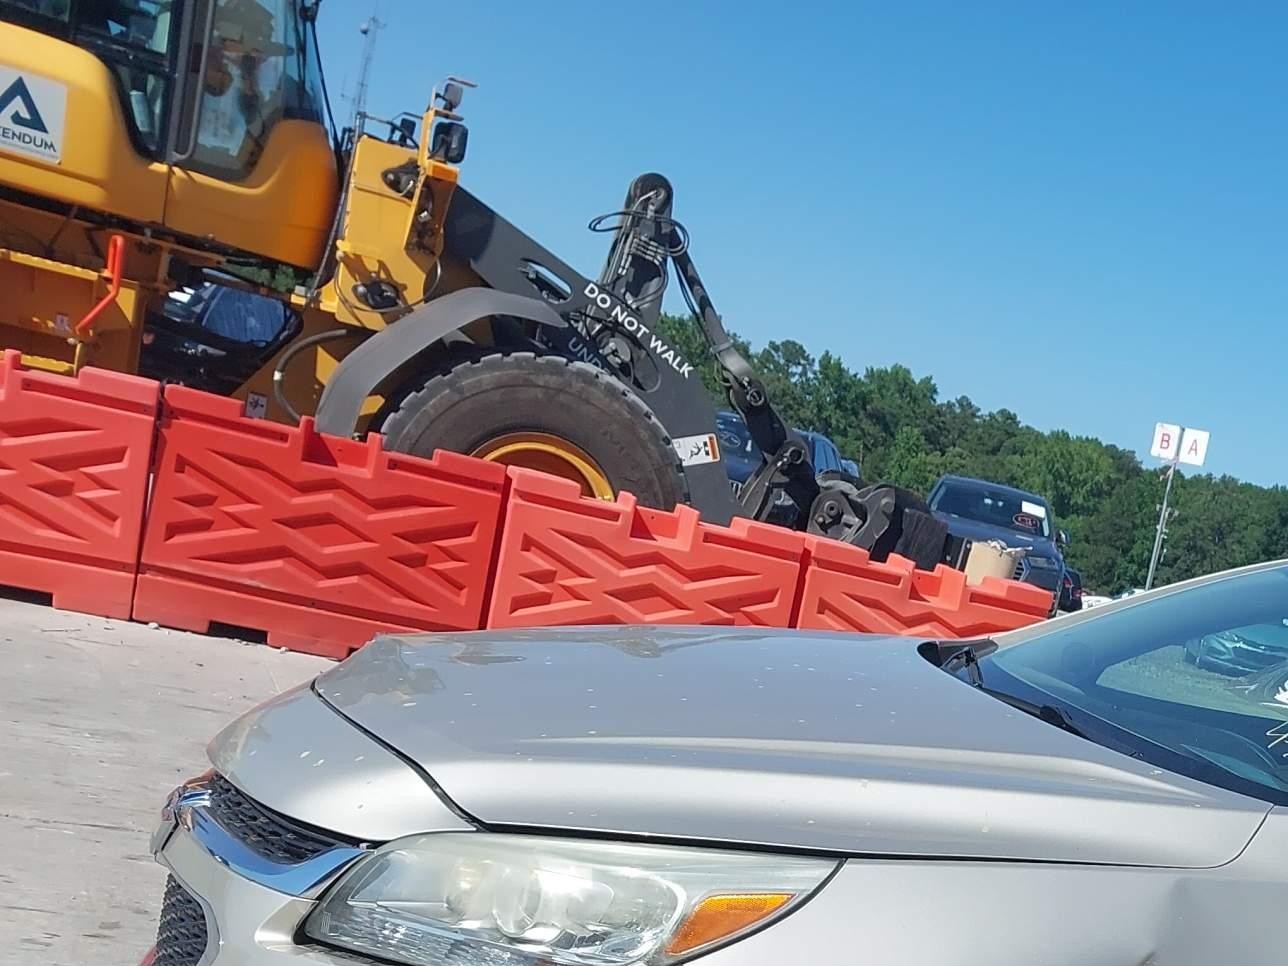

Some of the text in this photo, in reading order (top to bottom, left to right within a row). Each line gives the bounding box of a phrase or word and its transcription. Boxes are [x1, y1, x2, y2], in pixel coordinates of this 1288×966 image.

[584, 282, 695, 380] DO NOT WALK
[1160, 432, 1171, 450] B
[1187, 439, 1198, 457] A
